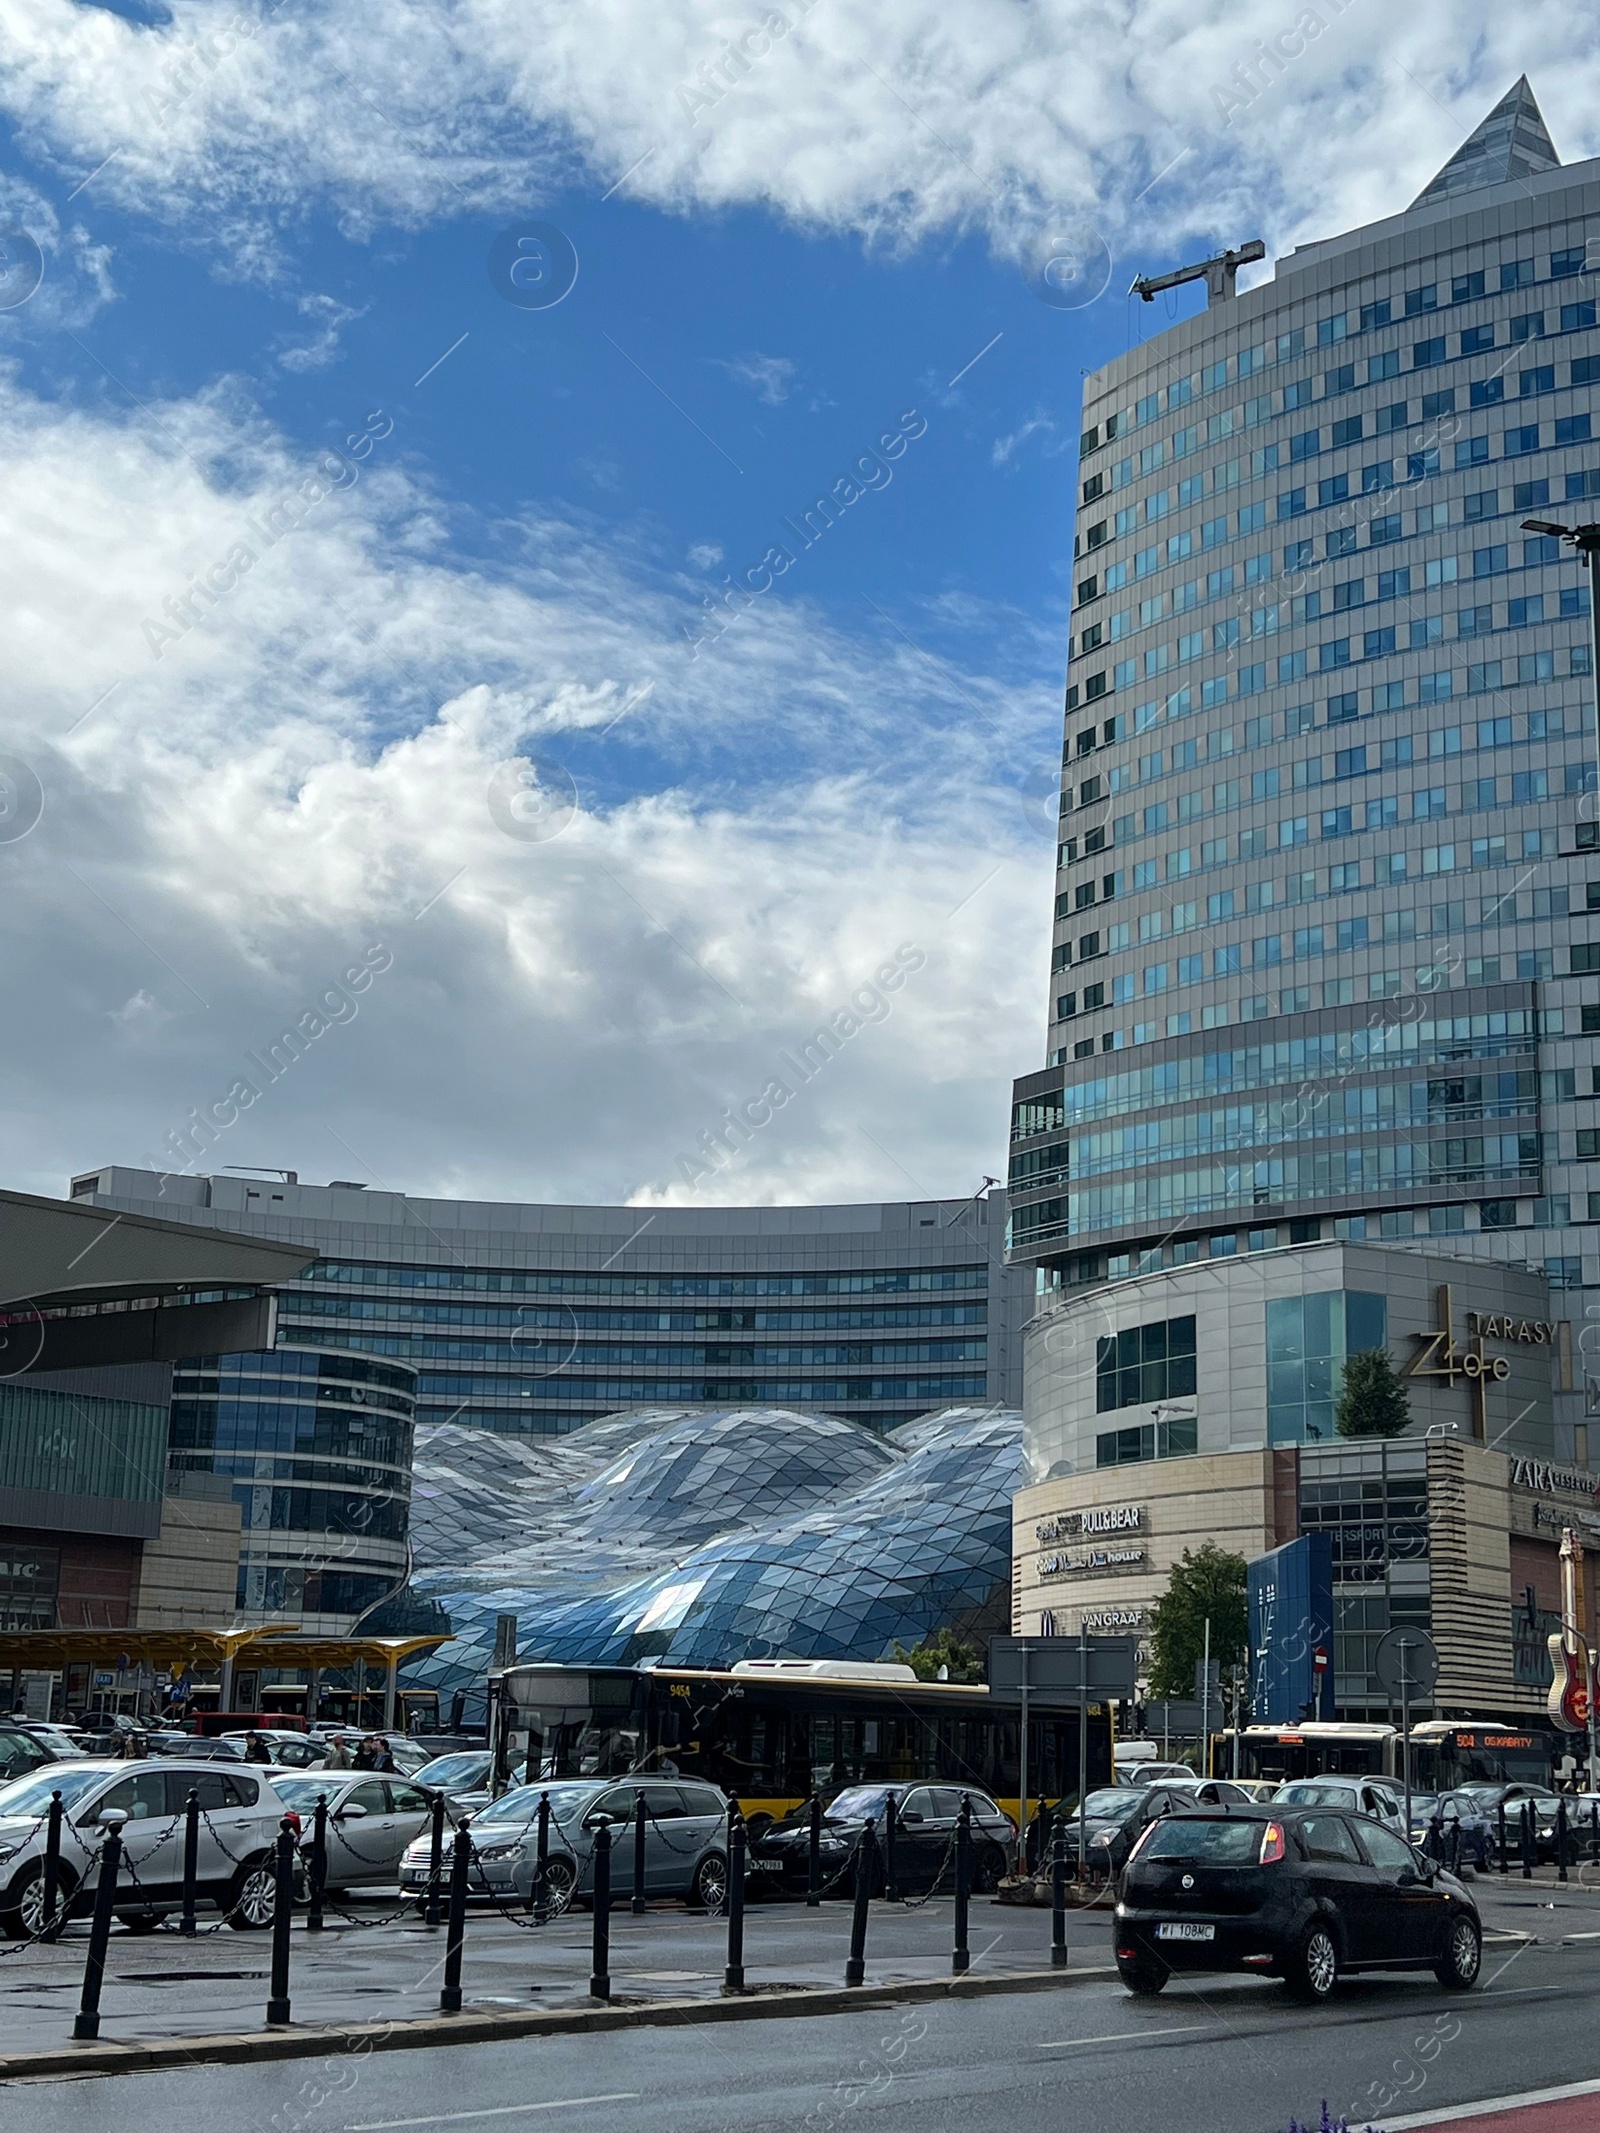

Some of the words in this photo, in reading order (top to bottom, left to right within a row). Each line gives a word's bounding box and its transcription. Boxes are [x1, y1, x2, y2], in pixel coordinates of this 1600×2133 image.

[1473, 1311, 1557, 1345] TARASY
[1512, 1459, 1555, 1492] ZARA
[1555, 1472, 1597, 1494] RESERVED
[1081, 1507, 1139, 1533] PULL&BEAR
[1329, 1528, 1385, 1542] TERSPORT
[1081, 1613, 1102, 1627] VAN
[1103, 1611, 1142, 1627] GRAAF
[669, 1684, 691, 1697] 9454
[1456, 1734, 1475, 1748] 504
